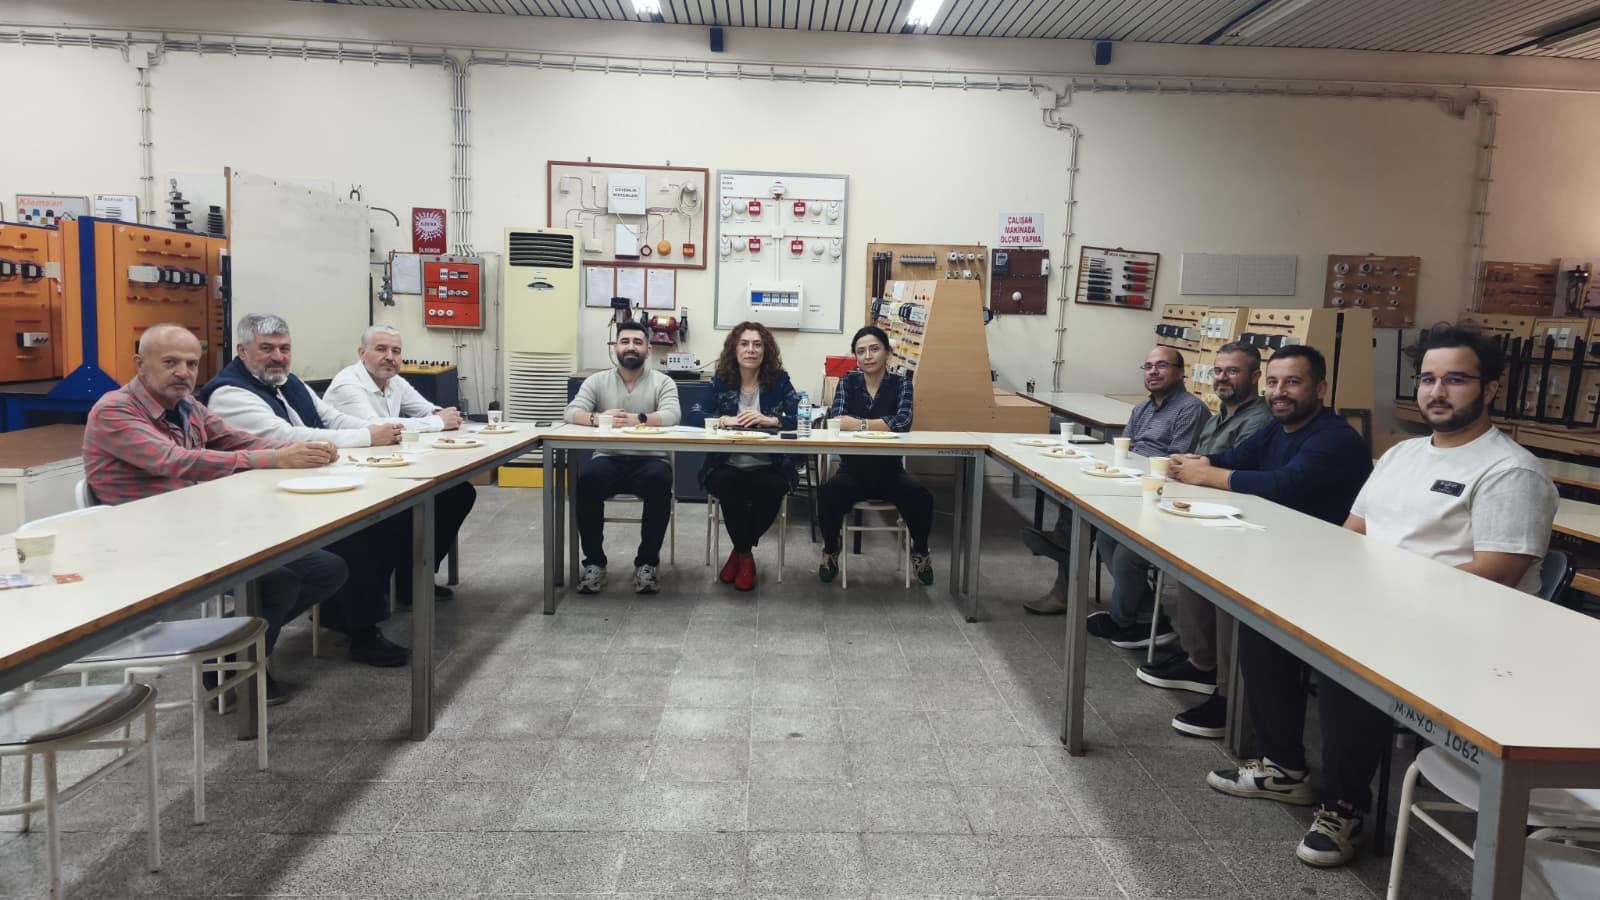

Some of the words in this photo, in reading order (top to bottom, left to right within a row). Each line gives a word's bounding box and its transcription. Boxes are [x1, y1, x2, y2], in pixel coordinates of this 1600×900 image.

[1007, 216, 1033, 225] ÇALIŞAN
[1004, 225, 1036, 234] MAKİNADA
[1022, 235, 1042, 243] YAPMA
[1444, 729, 1479, 764] 1062
